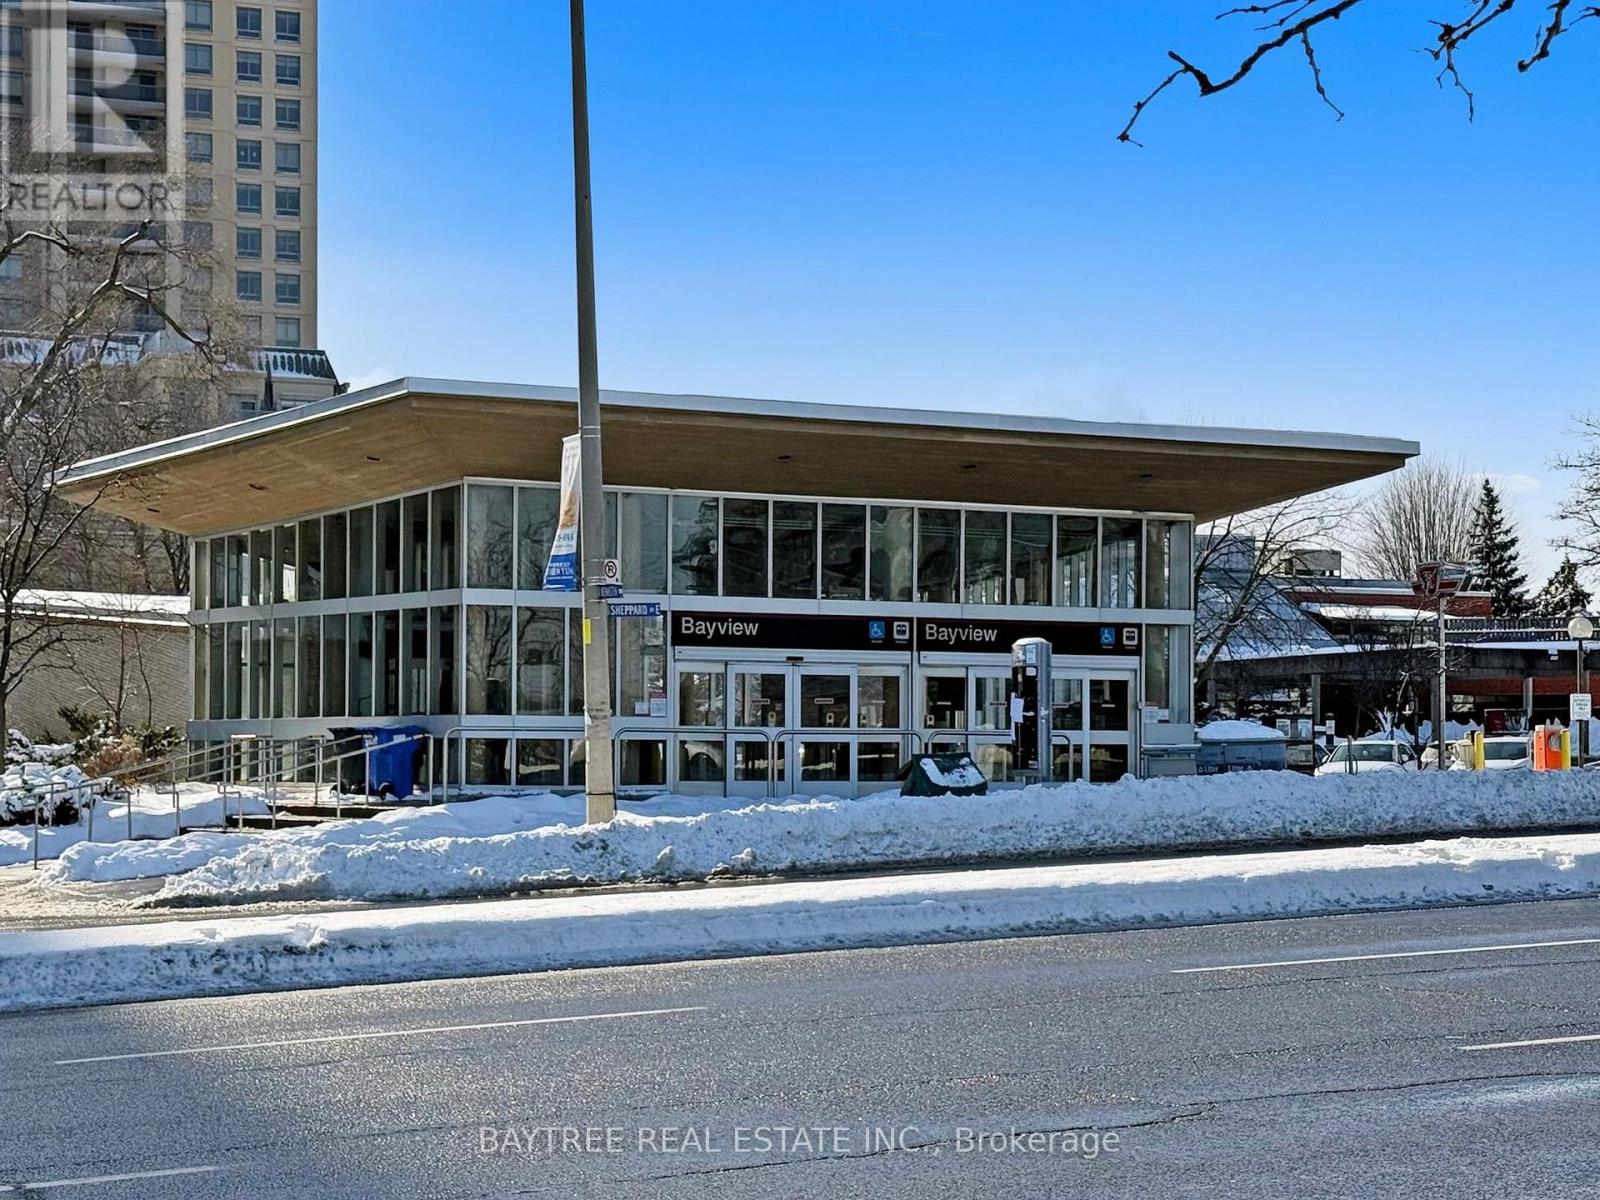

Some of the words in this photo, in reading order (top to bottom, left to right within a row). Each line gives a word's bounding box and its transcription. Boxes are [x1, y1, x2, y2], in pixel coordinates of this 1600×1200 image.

[610, 604, 648, 616] SHEPPARD
[681, 617, 759, 640] Bayview
[925, 623, 998, 645] Bayview
